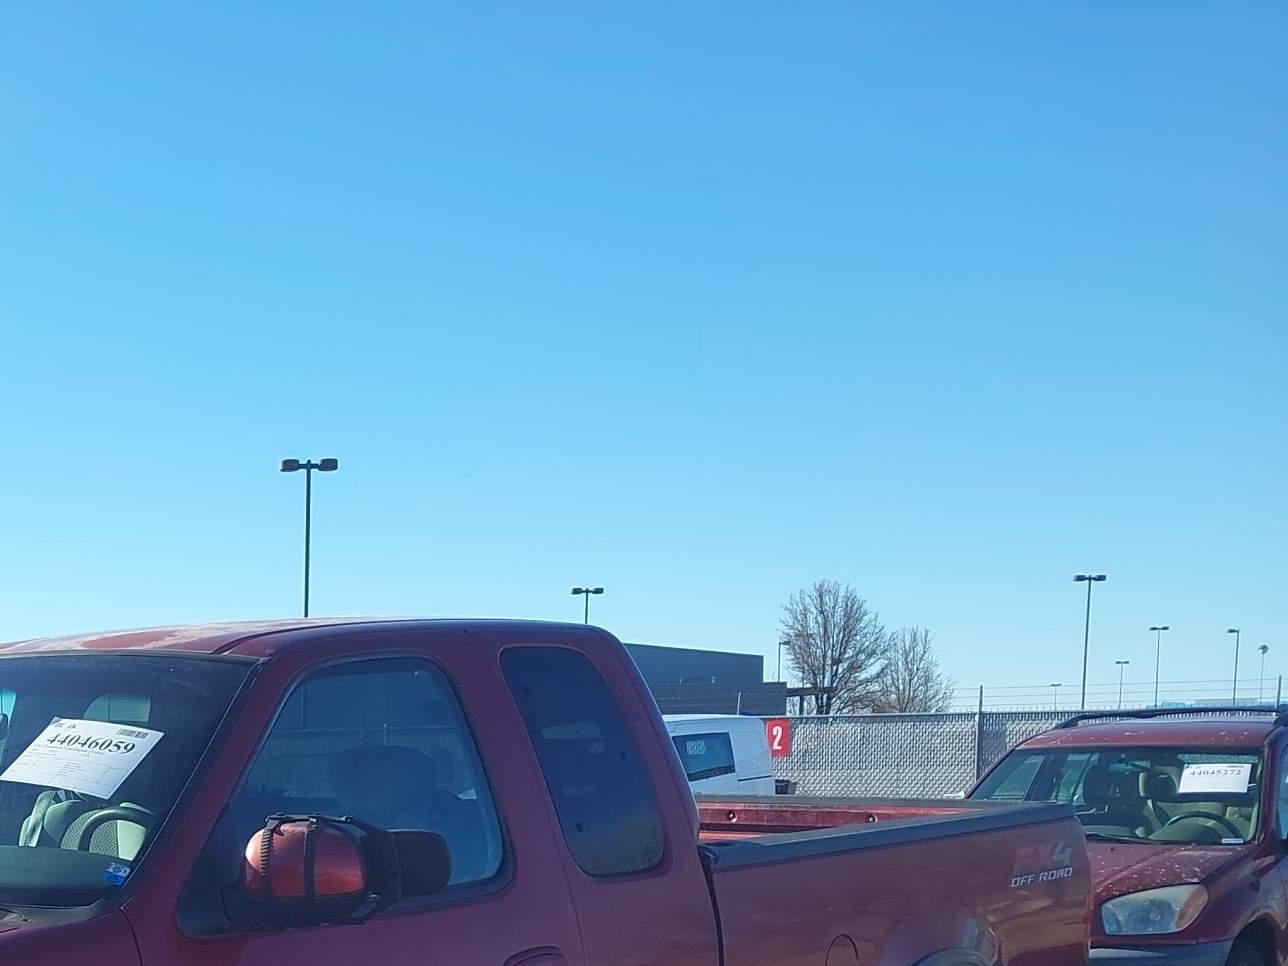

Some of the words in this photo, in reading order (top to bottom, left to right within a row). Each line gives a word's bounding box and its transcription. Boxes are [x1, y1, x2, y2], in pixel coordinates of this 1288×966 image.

[46, 732, 136, 755] 44046059
[772, 725, 783, 750] 2
[1189, 768, 1242, 776] 44045272
[1011, 874, 1035, 888] OFF
[1039, 867, 1073, 882] ROAD
